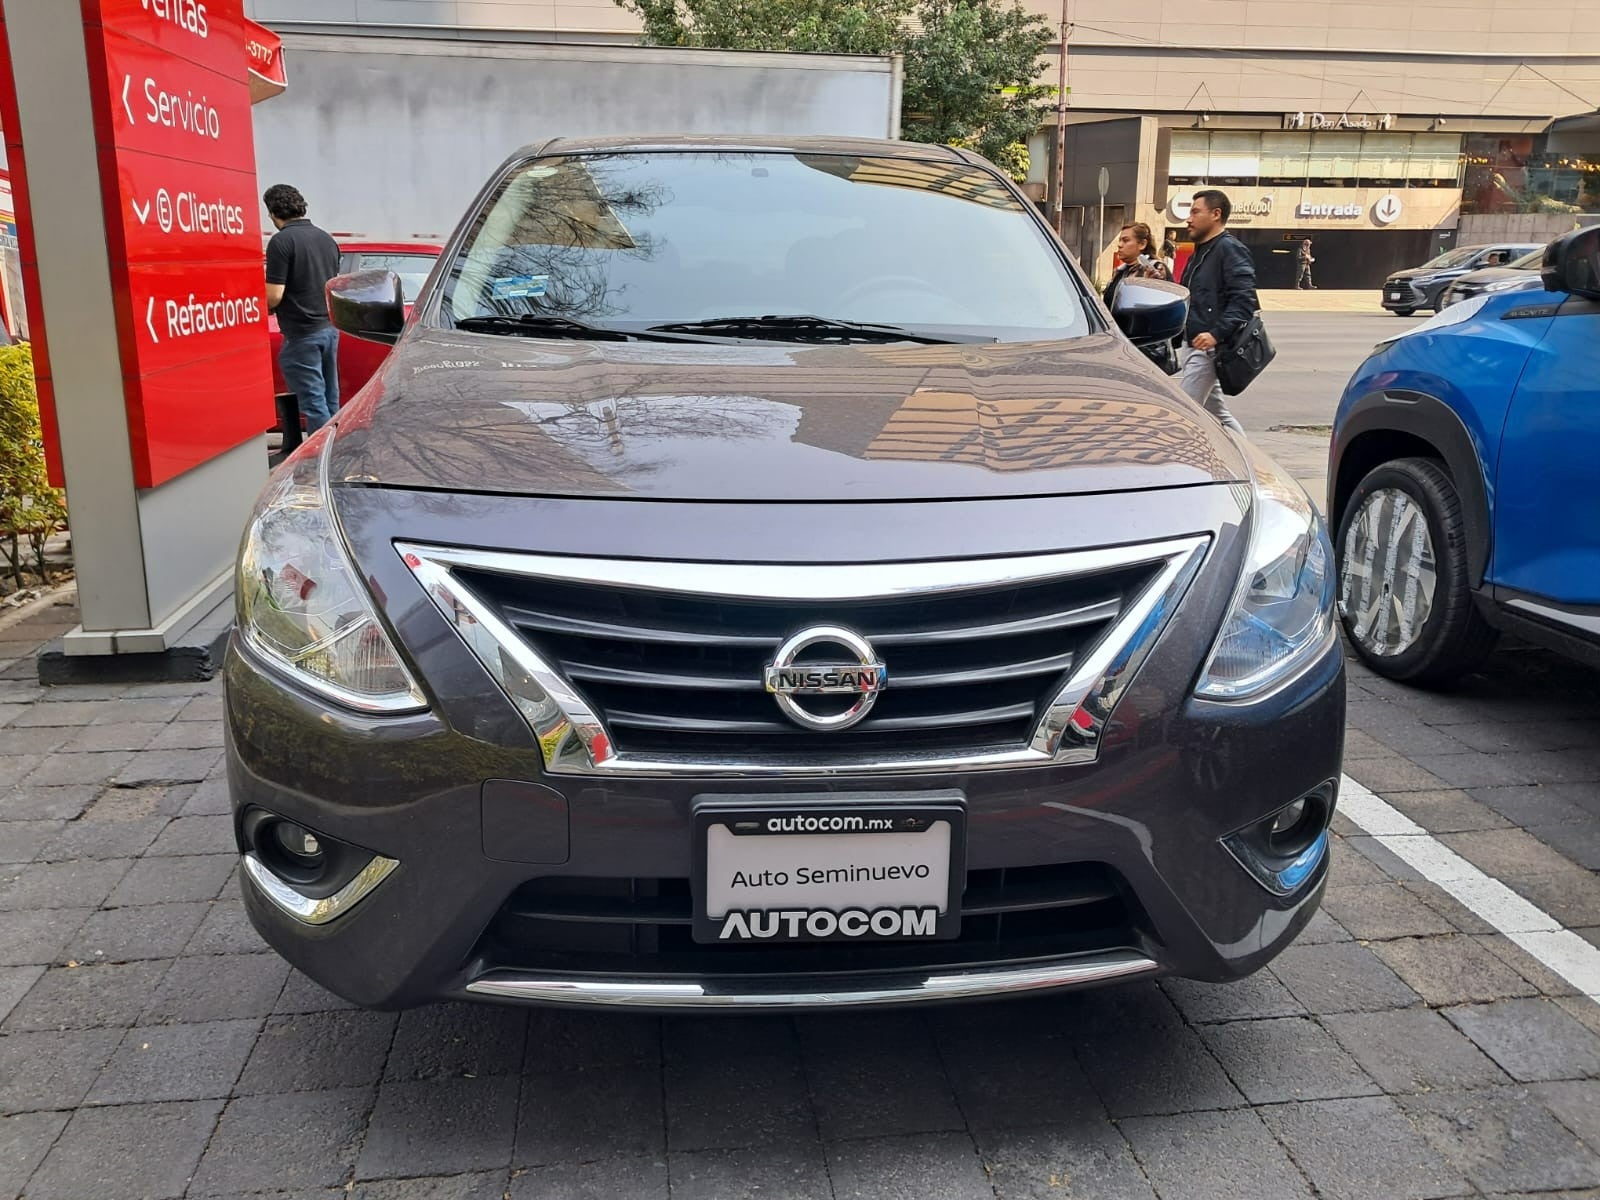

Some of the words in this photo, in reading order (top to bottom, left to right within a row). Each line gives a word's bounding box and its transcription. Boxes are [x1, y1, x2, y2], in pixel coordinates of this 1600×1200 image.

[140, 0, 208, 38] entas
[145, 78, 219, 139] Servicio
[1312, 113, 1334, 128] Don
[176, 192, 244, 235] Clientes
[1300, 202, 1363, 217] Entrada
[166, 292, 260, 338] Refacciones
[779, 671, 874, 688] NISSAN
[767, 815, 893, 832] autocom.mx
[731, 869, 789, 888] Auto
[796, 863, 930, 885] Seminuevo
[719, 909, 936, 939] AUTOCOM
